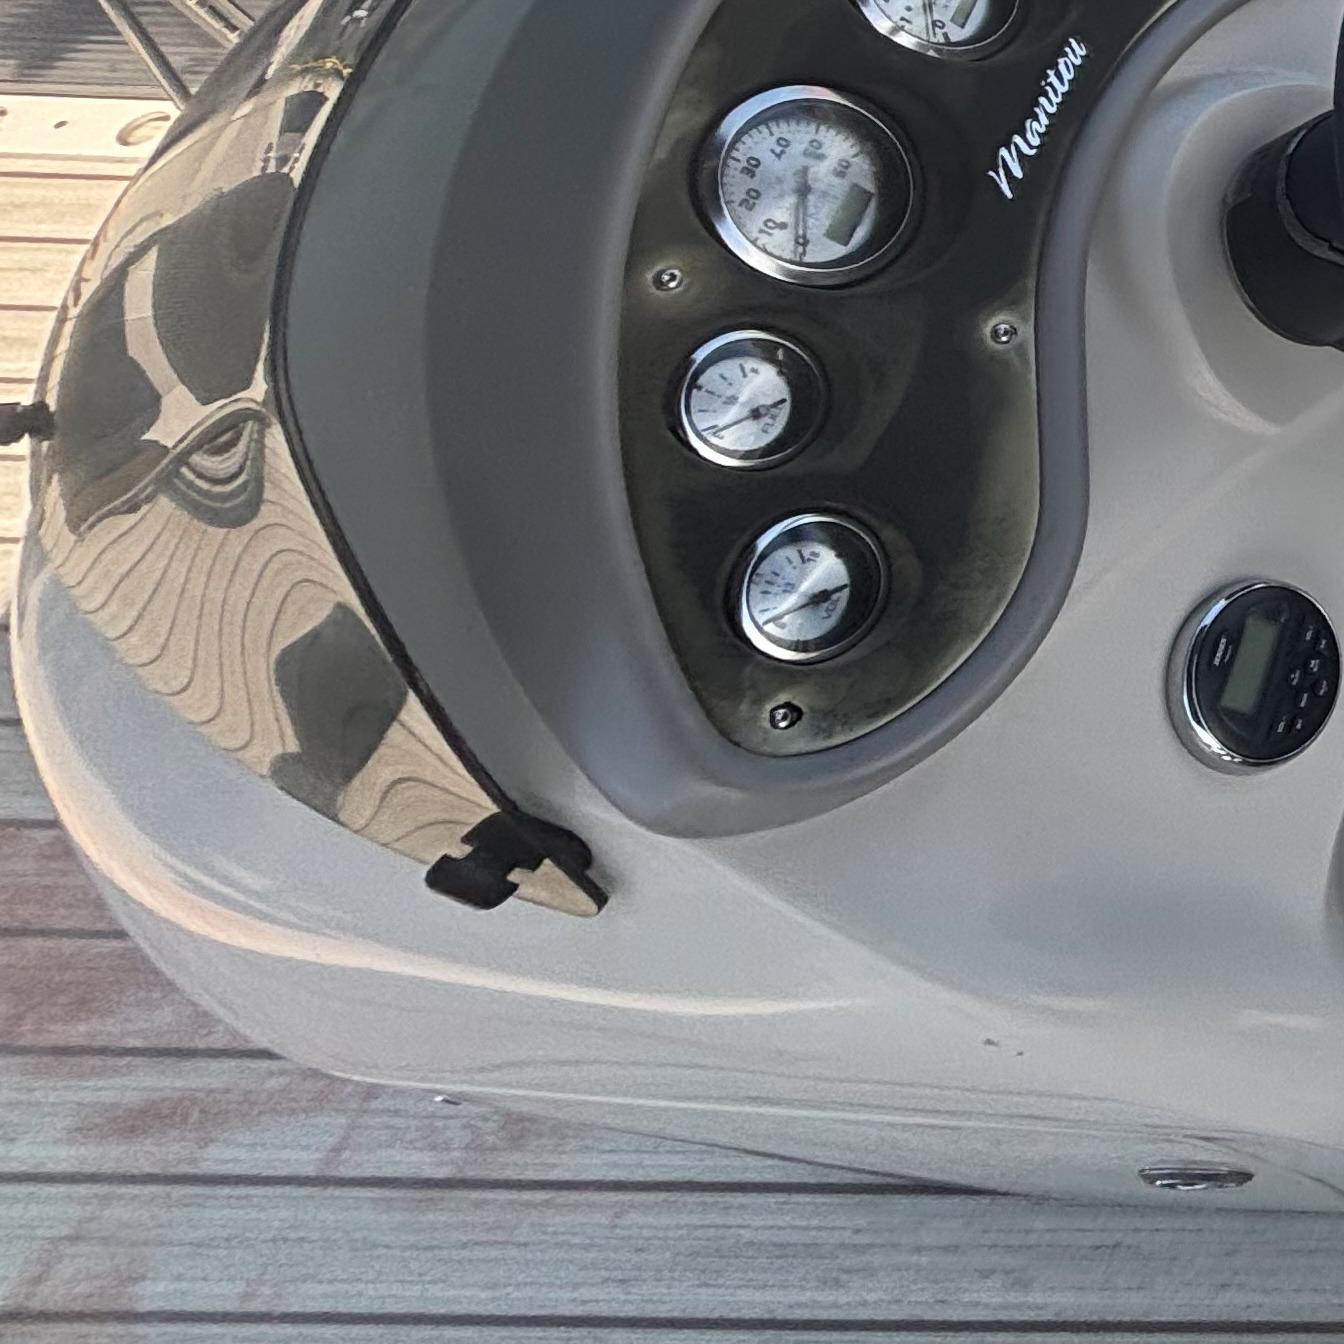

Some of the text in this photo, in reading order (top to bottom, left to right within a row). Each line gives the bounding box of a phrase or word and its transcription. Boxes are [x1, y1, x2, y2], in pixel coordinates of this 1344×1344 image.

[987, 37, 1087, 200] Manitou
[770, 136, 792, 160] 40
[739, 156, 762, 180] 30
[738, 187, 762, 212] 20
